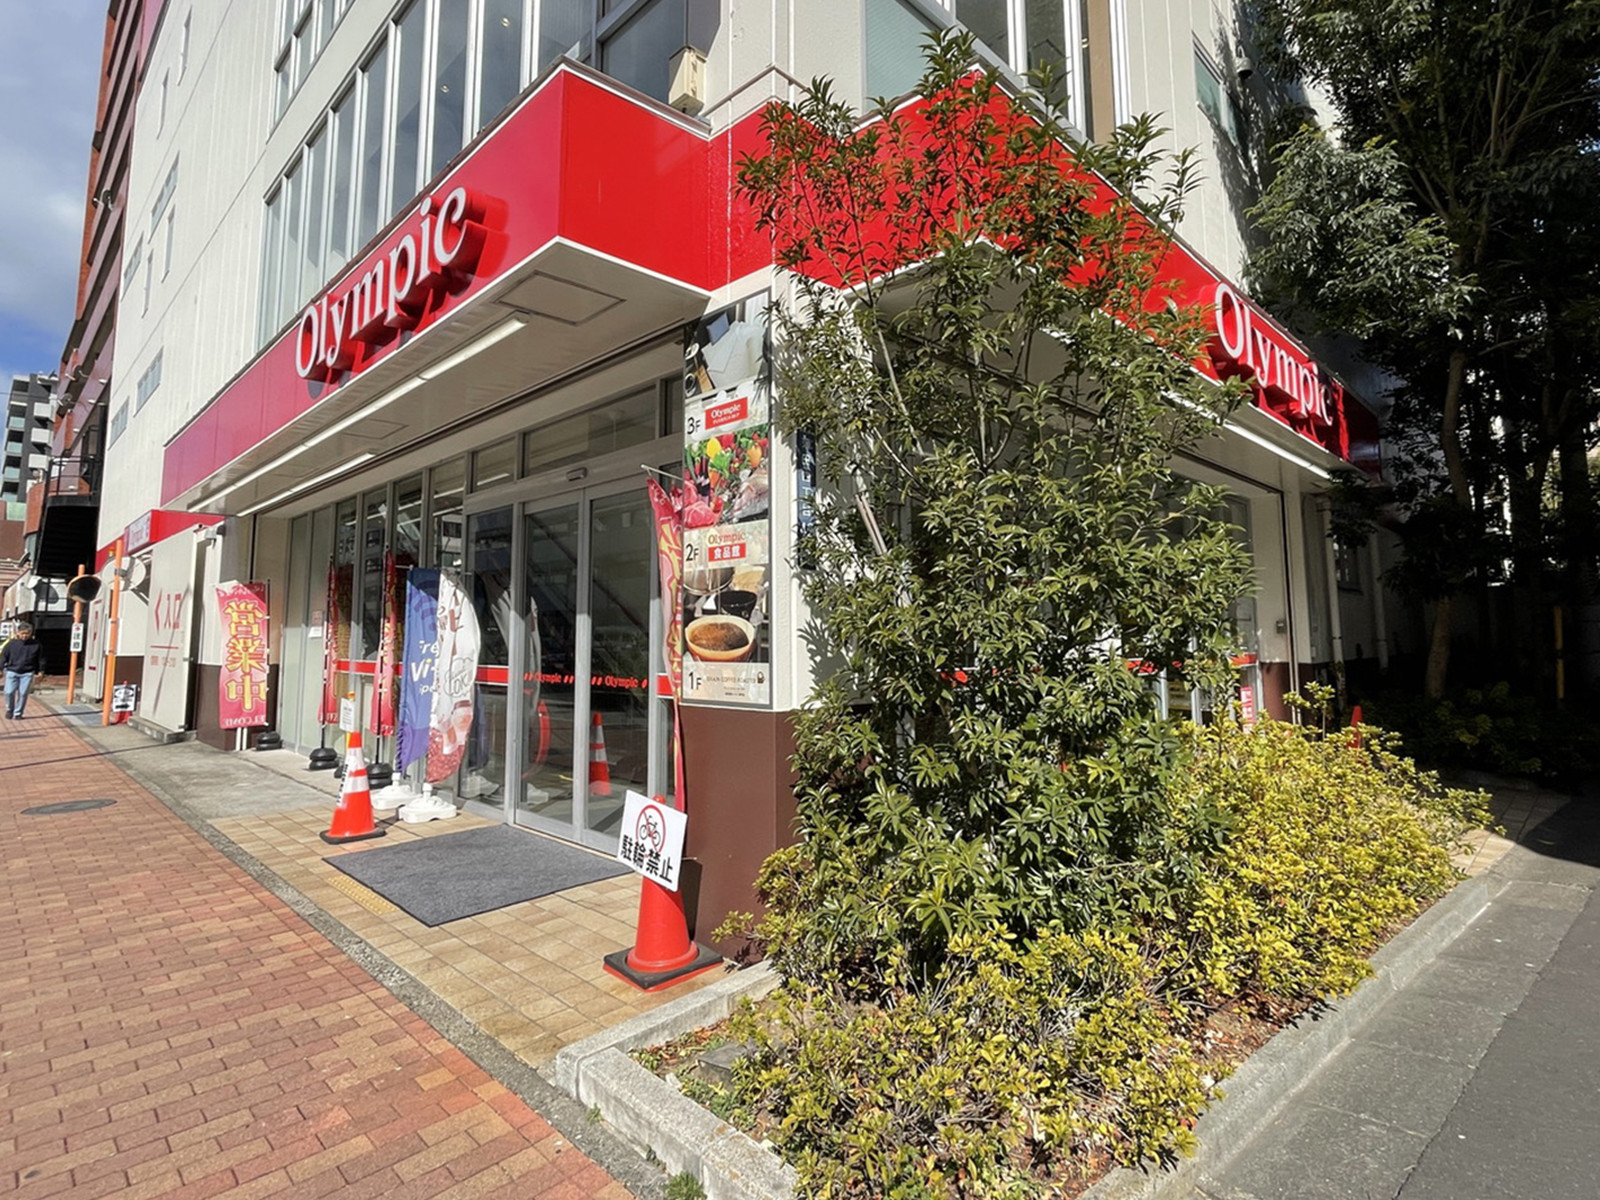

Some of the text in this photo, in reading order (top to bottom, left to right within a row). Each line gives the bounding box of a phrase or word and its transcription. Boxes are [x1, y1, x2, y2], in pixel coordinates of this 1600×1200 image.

[295, 186, 467, 378] Olympic
[1215, 282, 1333, 427] Olympic
[687, 416, 701, 435] 3F
[708, 531, 746, 544] Olympic
[685, 543, 699, 561] 2F
[534, 673, 562, 684] Olympic
[604, 675, 638, 688] Olympic
[688, 671, 702, 690] 1F
[620, 834, 673, 884] 駐輪禁止
